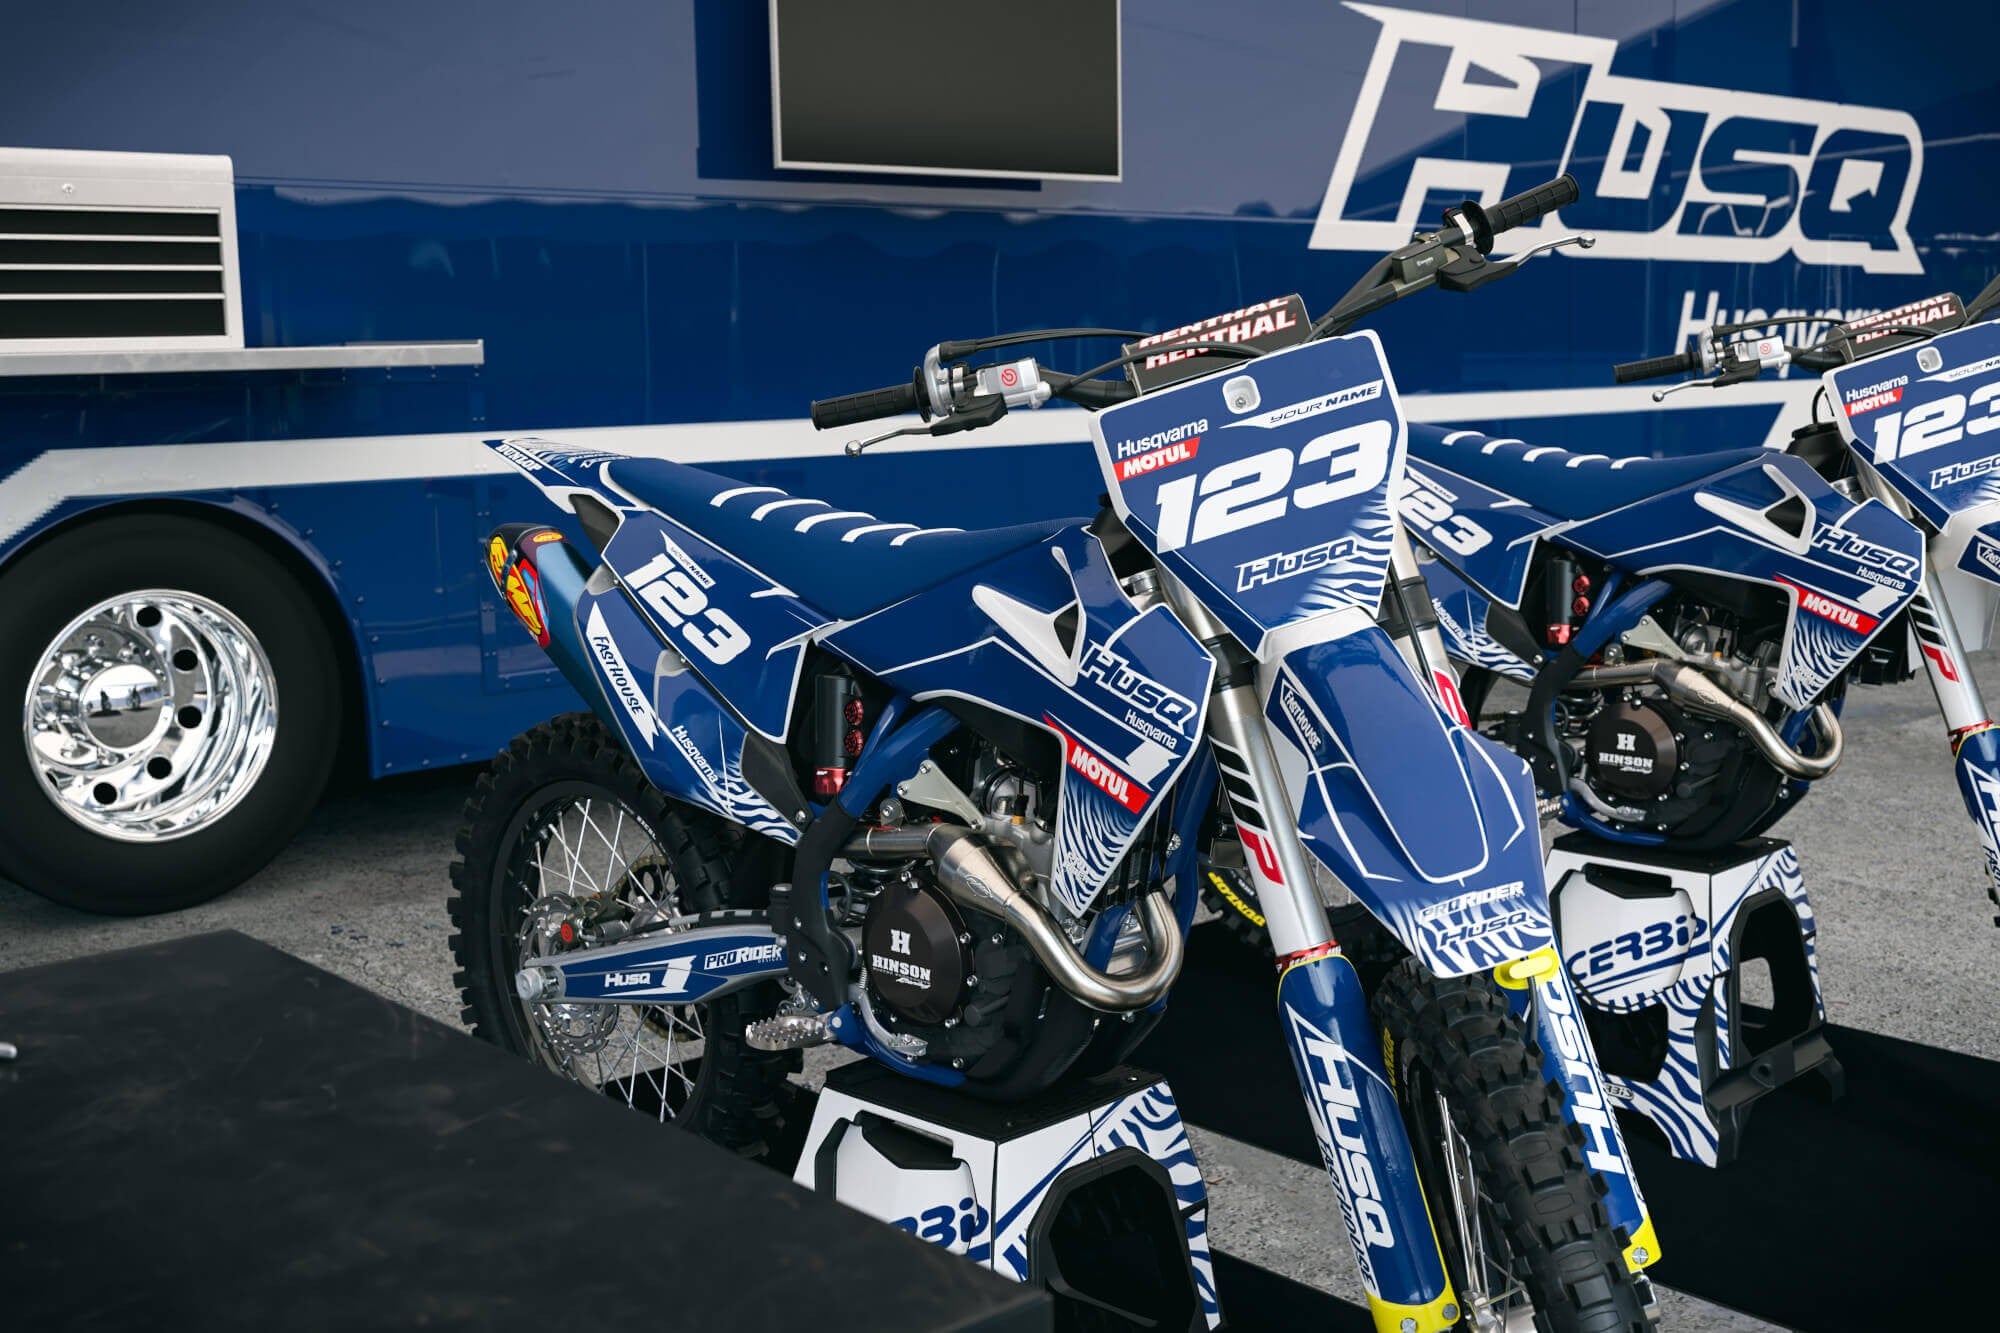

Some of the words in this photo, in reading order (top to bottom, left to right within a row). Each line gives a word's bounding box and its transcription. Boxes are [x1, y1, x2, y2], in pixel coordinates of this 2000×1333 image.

[1308, 1, 1925, 275] HUSQ
[1269, 402, 1323, 423] YOUR
[1325, 385, 1378, 407] NAME
[1845, 375, 1909, 402] Husqvarna
[1850, 391, 1898, 416] MOTUL
[496, 444, 542, 471] DUNLOP
[1117, 418, 1208, 459] Husqvarna
[1123, 443, 1191, 479] MOTUL
[1156, 419, 1392, 554] 123
[1233, 535, 1362, 593] HUSQ
[1810, 522, 1921, 579] HUSQ
[1856, 565, 1906, 591] Husqvarna
[623, 553, 751, 665] 123
[1803, 593, 1860, 629] MOTUL
[593, 635, 645, 715] FASTHOUSE
[1080, 640, 1198, 736] HUSQ
[1124, 709, 1178, 750] Husqvarna
[1285, 690, 1322, 751] FASTHOUSE
[672, 724, 718, 784] Husqvarna
[1599, 752, 1654, 769] HINSON
[1616, 733, 1636, 751] H
[1071, 745, 1130, 804] MOTUL
[1208, 872, 1266, 928] DUNLOP
[890, 929, 911, 956] H
[1438, 909, 1532, 949] HUSQ
[604, 971, 652, 989] HUSQ
[872, 954, 931, 982] HINSON
[1304, 1036, 1395, 1249] HUSQ
